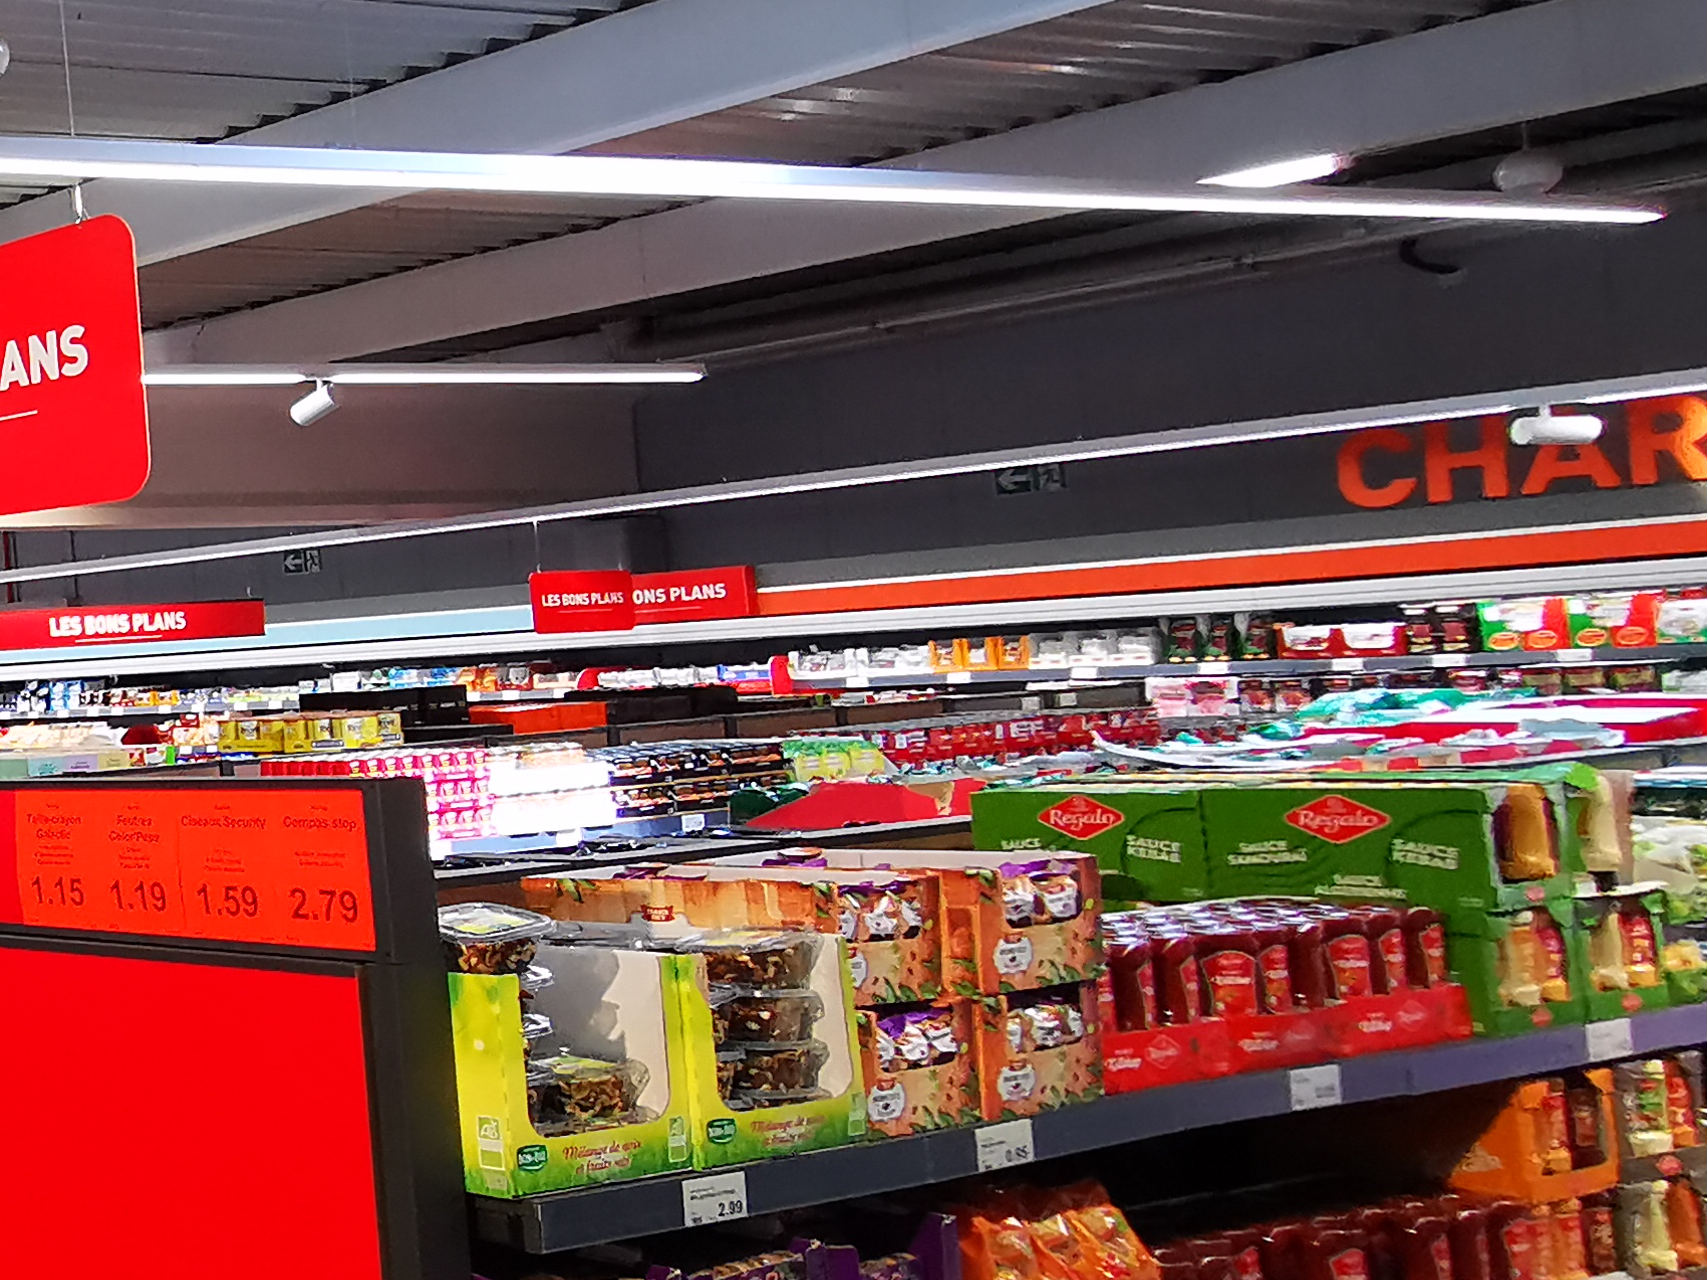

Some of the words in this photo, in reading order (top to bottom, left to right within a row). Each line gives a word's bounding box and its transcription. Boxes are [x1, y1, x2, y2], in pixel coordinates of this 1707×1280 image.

[542, 593, 561, 607] LES
[562, 593, 590, 606] BONS
[669, 583, 727, 601] PLANS
[49, 617, 82, 638] LES
[84, 614, 130, 636] BONS
[132, 611, 187, 633] PLANS
[1049, 808, 1115, 831] Regalo
[1298, 809, 1379, 833] Regalo
[31, 876, 85, 907] 1.15
[110, 879, 167, 912] 1.19
[197, 882, 259, 918] 1.59
[289, 886, 359, 923] 2.79
